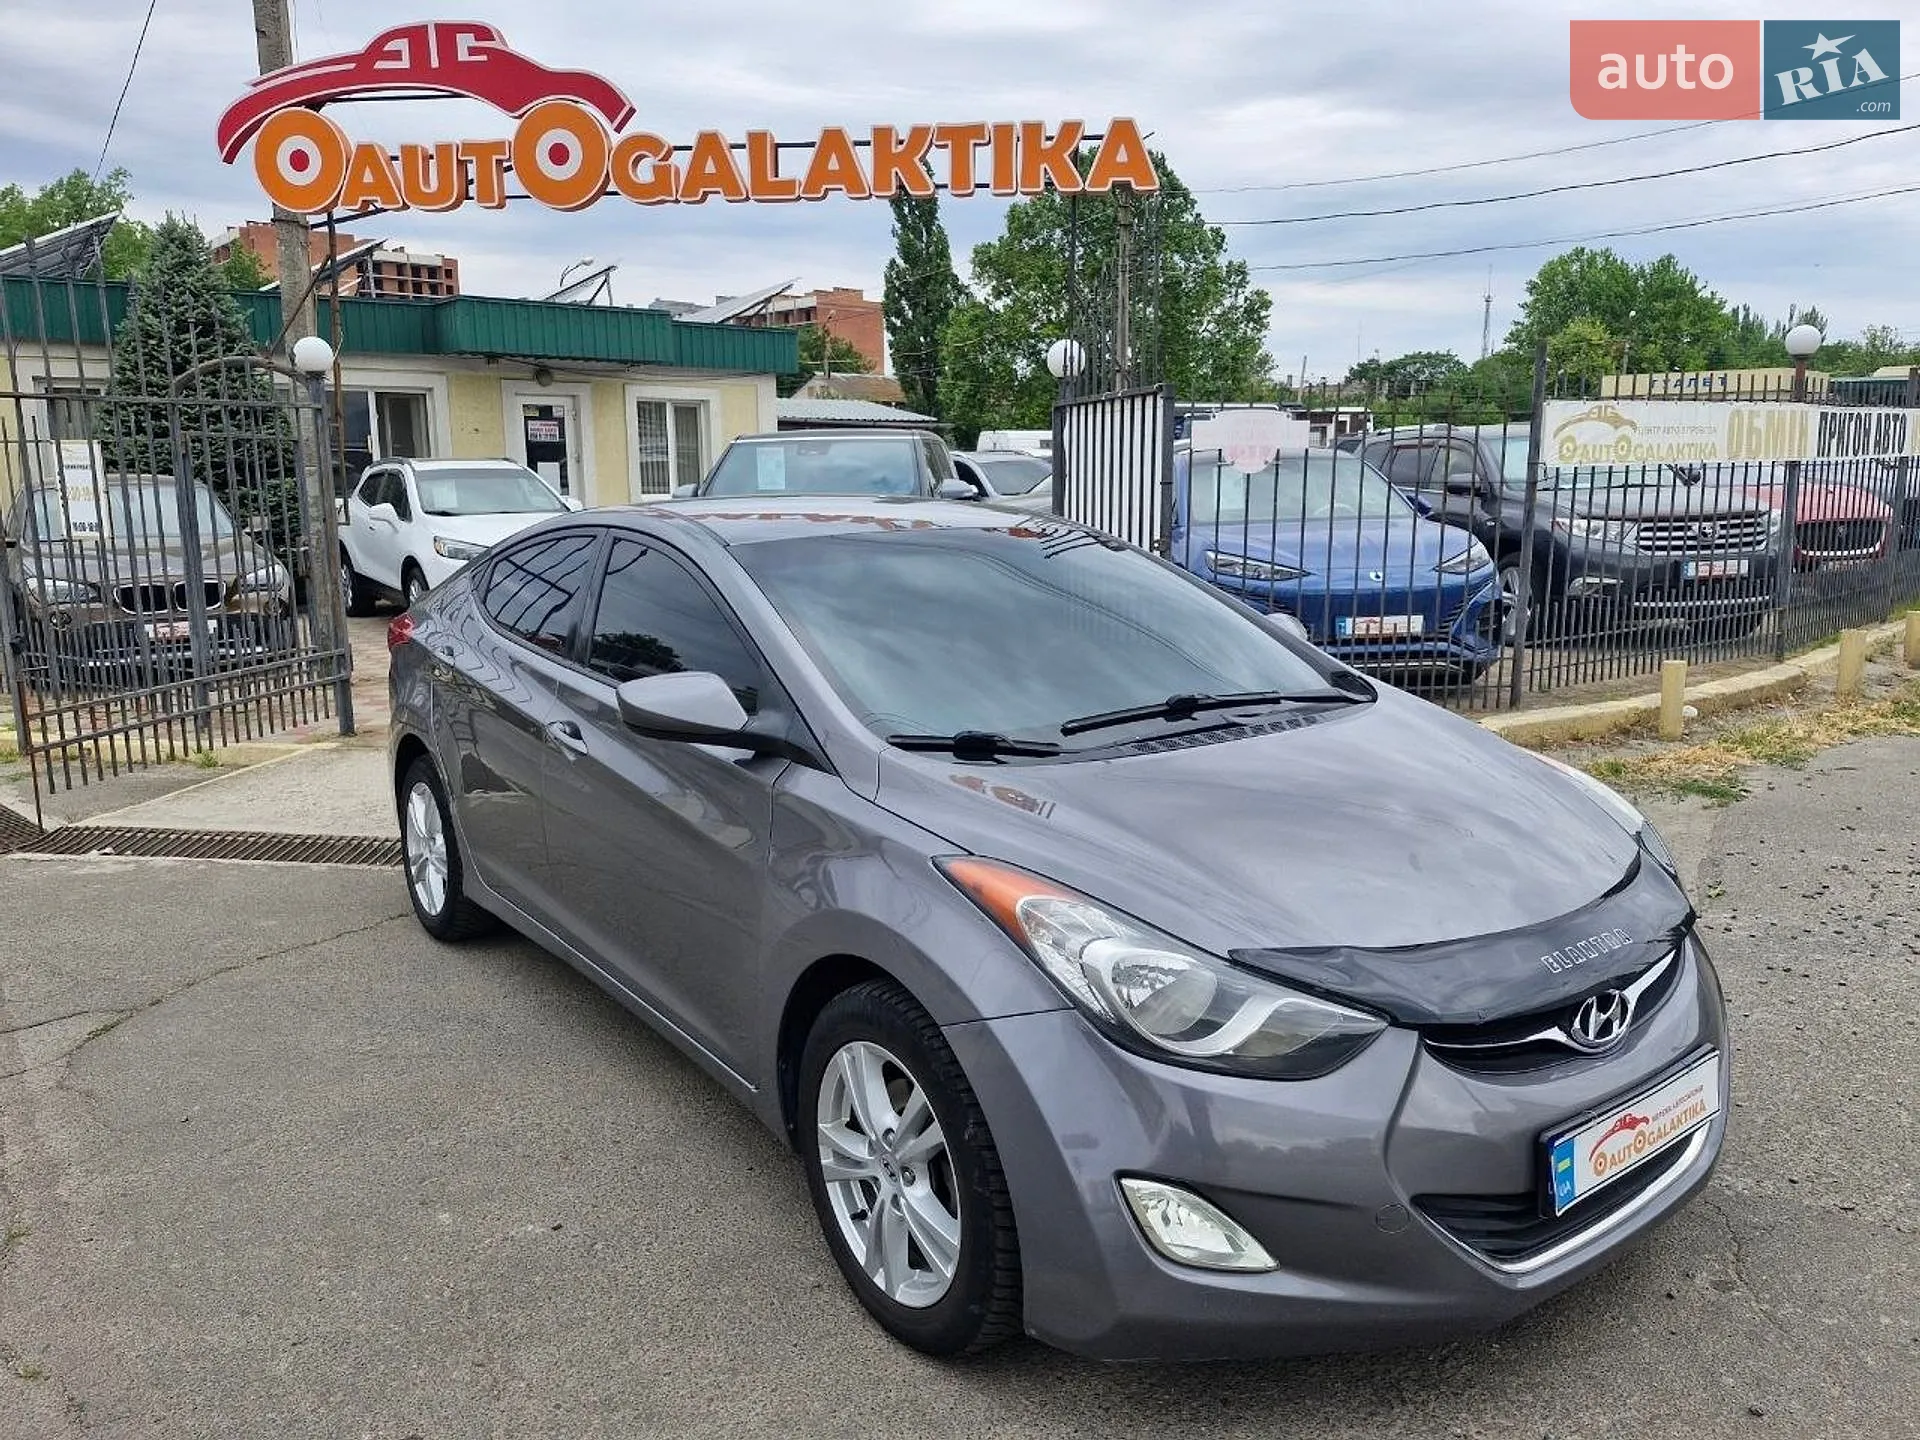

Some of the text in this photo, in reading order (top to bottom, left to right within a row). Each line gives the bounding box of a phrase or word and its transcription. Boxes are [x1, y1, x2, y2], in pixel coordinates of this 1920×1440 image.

[1817, 411, 1872, 457] ПРИГОН
[1874, 411, 1908, 456] АВТО
[1541, 928, 1632, 973] ELANTRA
